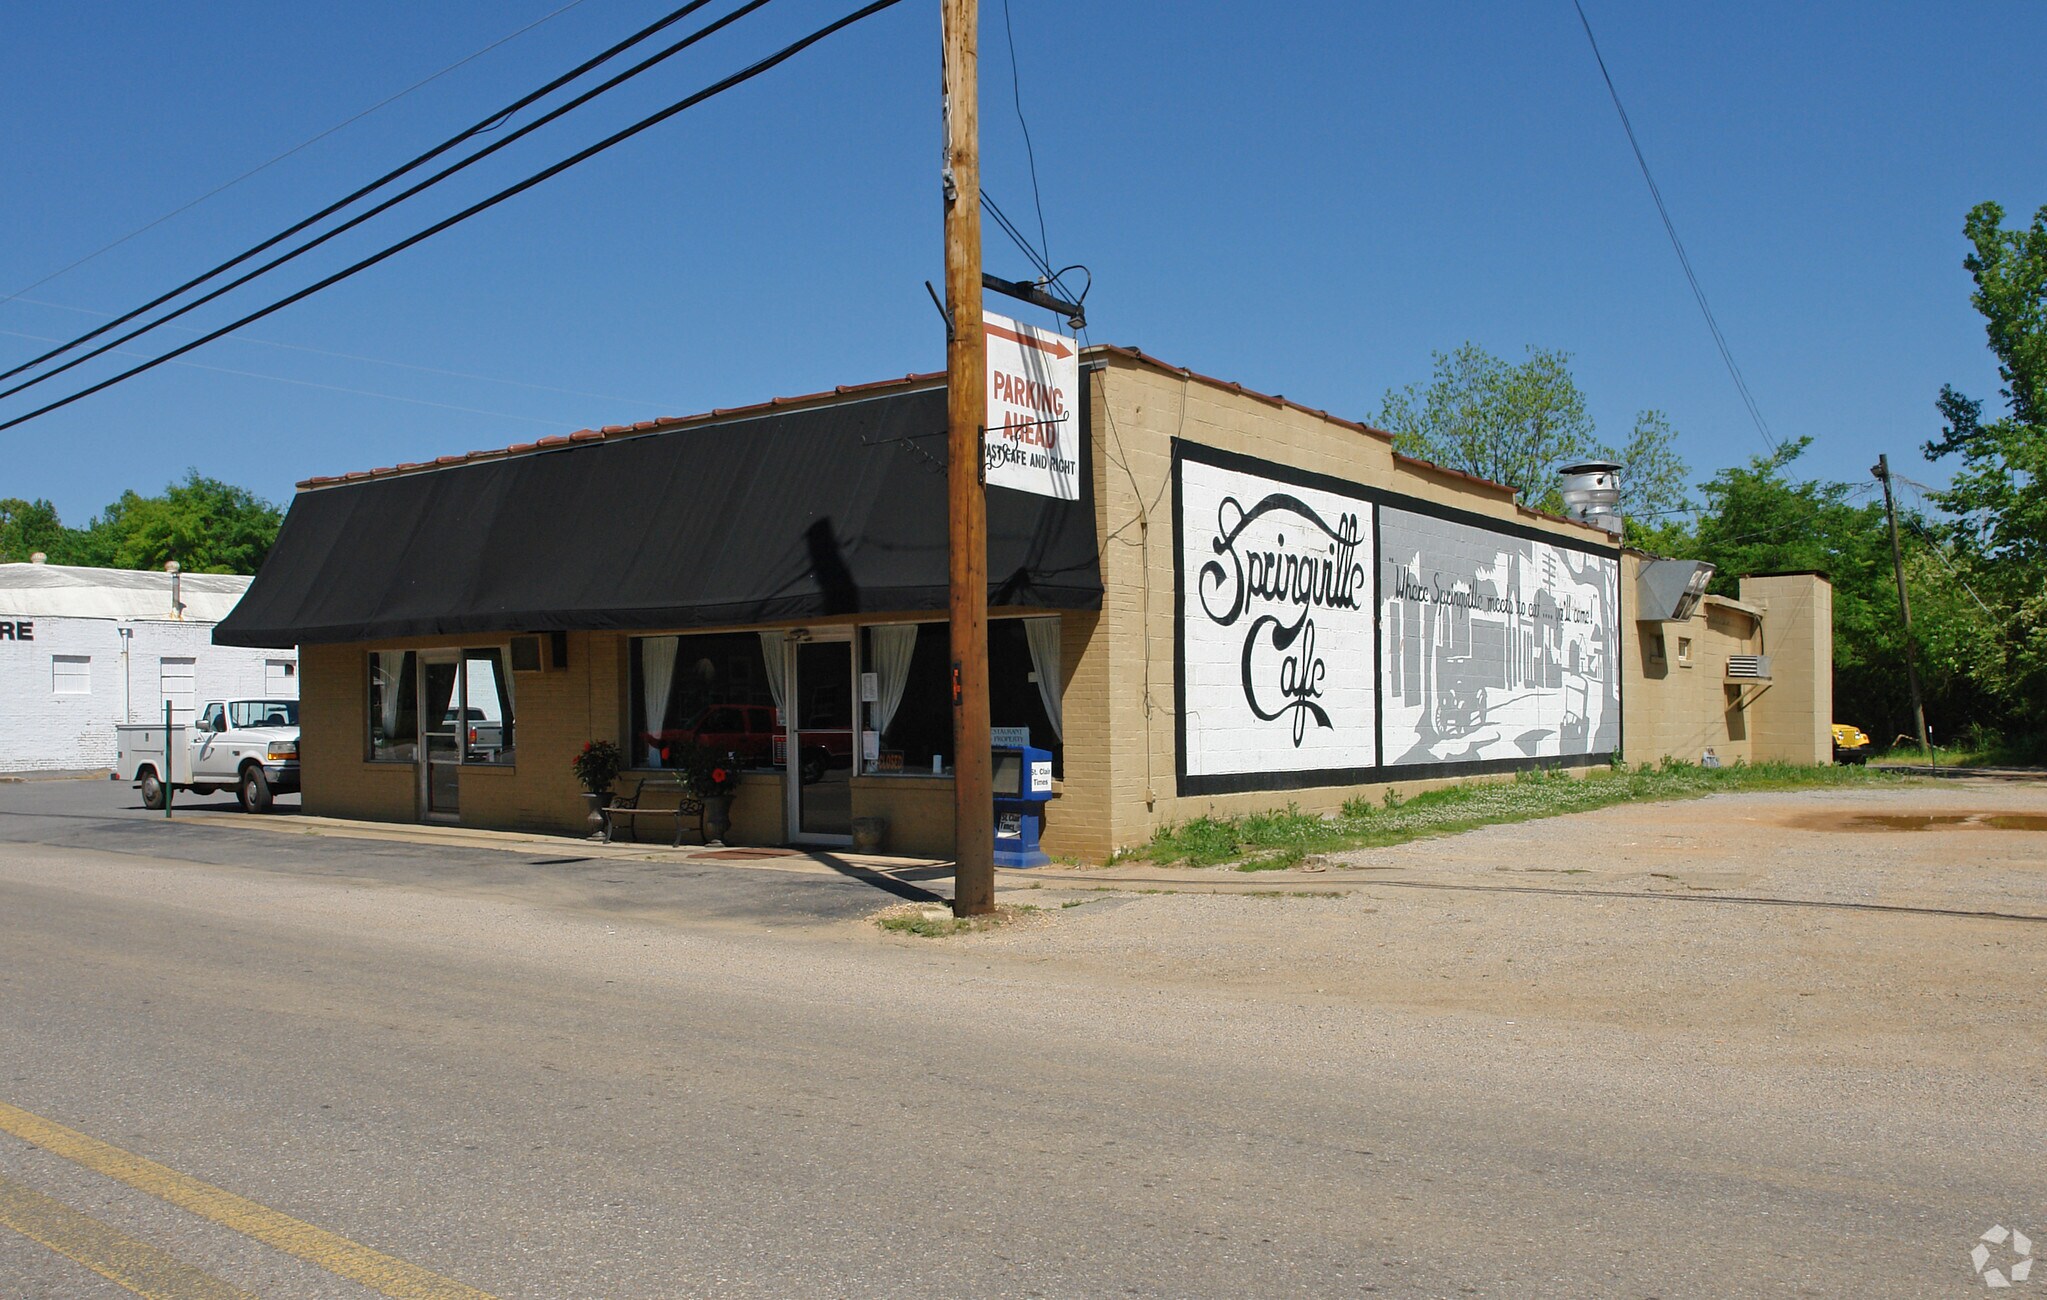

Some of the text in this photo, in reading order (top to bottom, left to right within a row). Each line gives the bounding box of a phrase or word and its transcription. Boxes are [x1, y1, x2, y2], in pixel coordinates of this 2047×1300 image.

[993, 370, 1064, 417] PARKING
[1003, 410, 1056, 449] AHEAD
[984, 443, 1076, 475] AST CAFE AND RIGHT
[1199, 492, 1366, 630] Springville
[1431, 572, 1483, 619] Springville
[1241, 614, 1334, 748] Cafe
